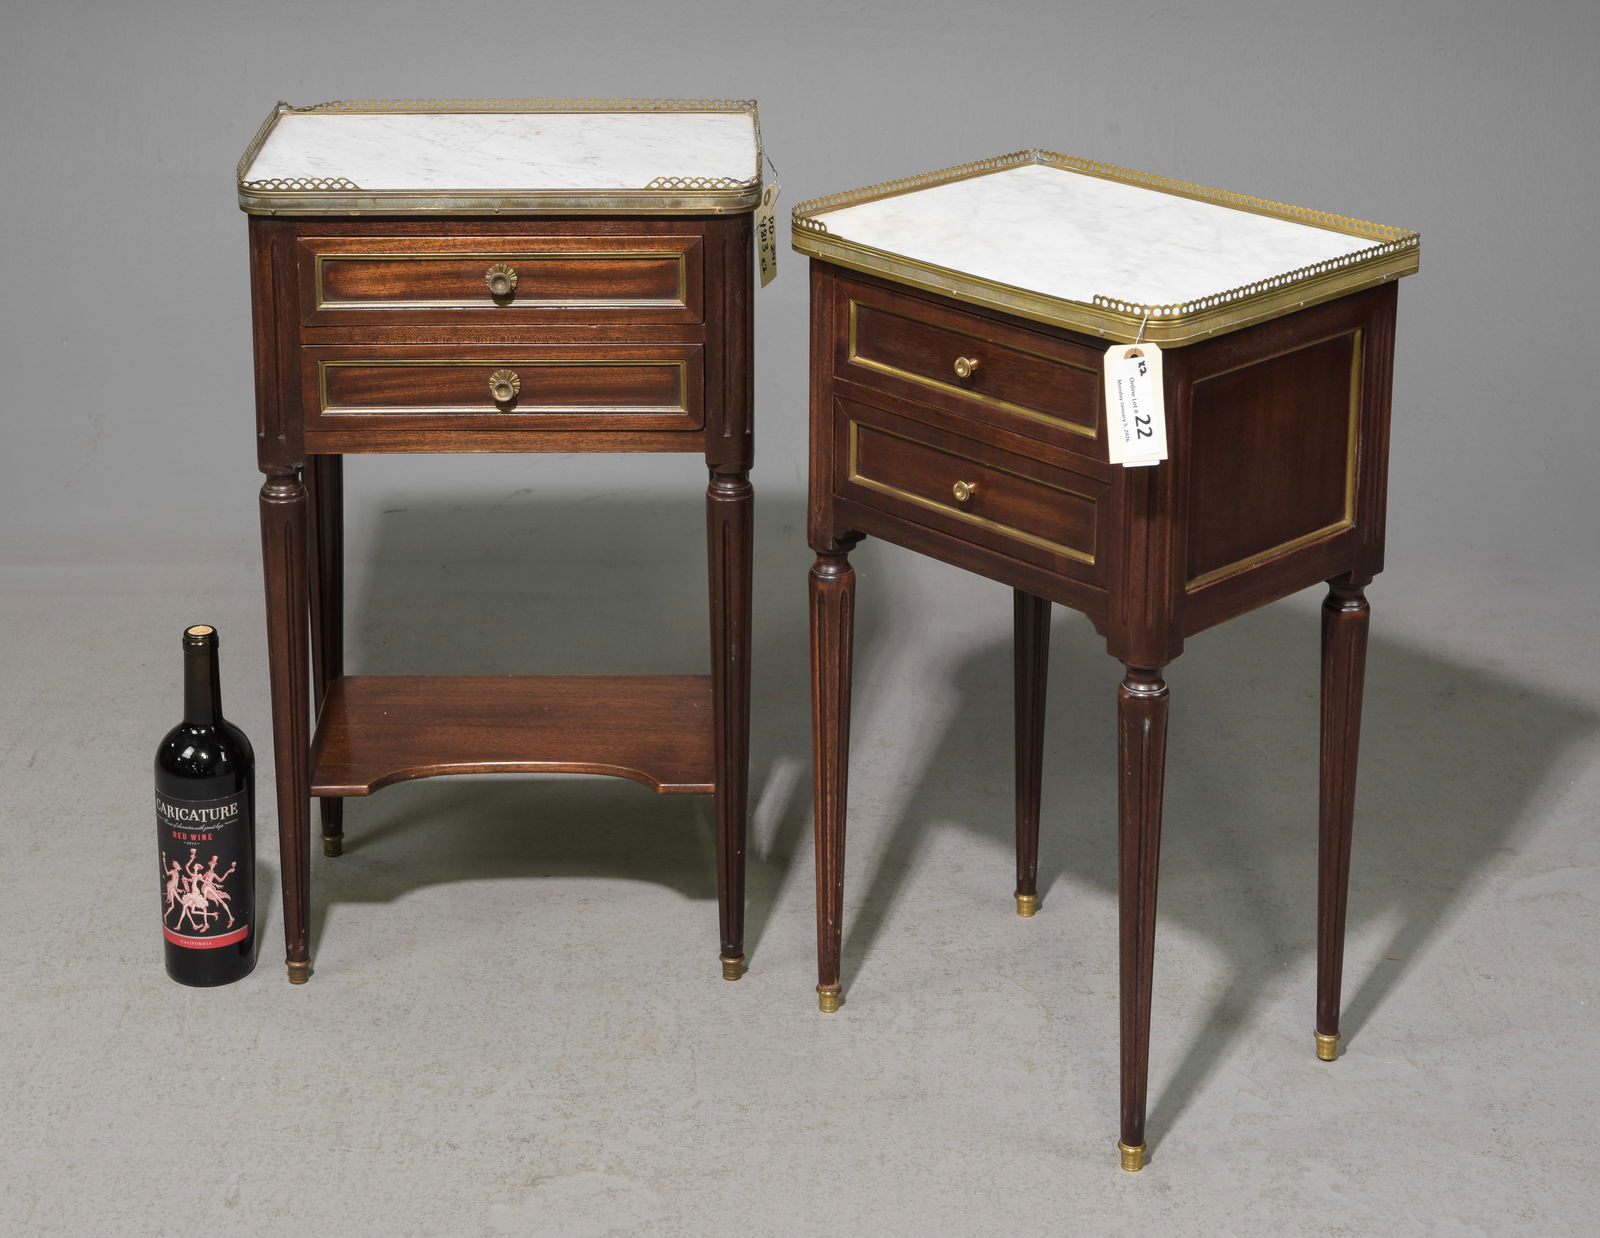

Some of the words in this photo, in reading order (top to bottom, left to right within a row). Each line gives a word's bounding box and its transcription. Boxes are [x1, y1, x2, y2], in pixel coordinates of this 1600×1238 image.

[1135, 414, 1153, 440] 22
[156, 798, 238, 822] CARICATURE
[172, 830, 187, 840] RED
[190, 833, 213, 841] WINE
